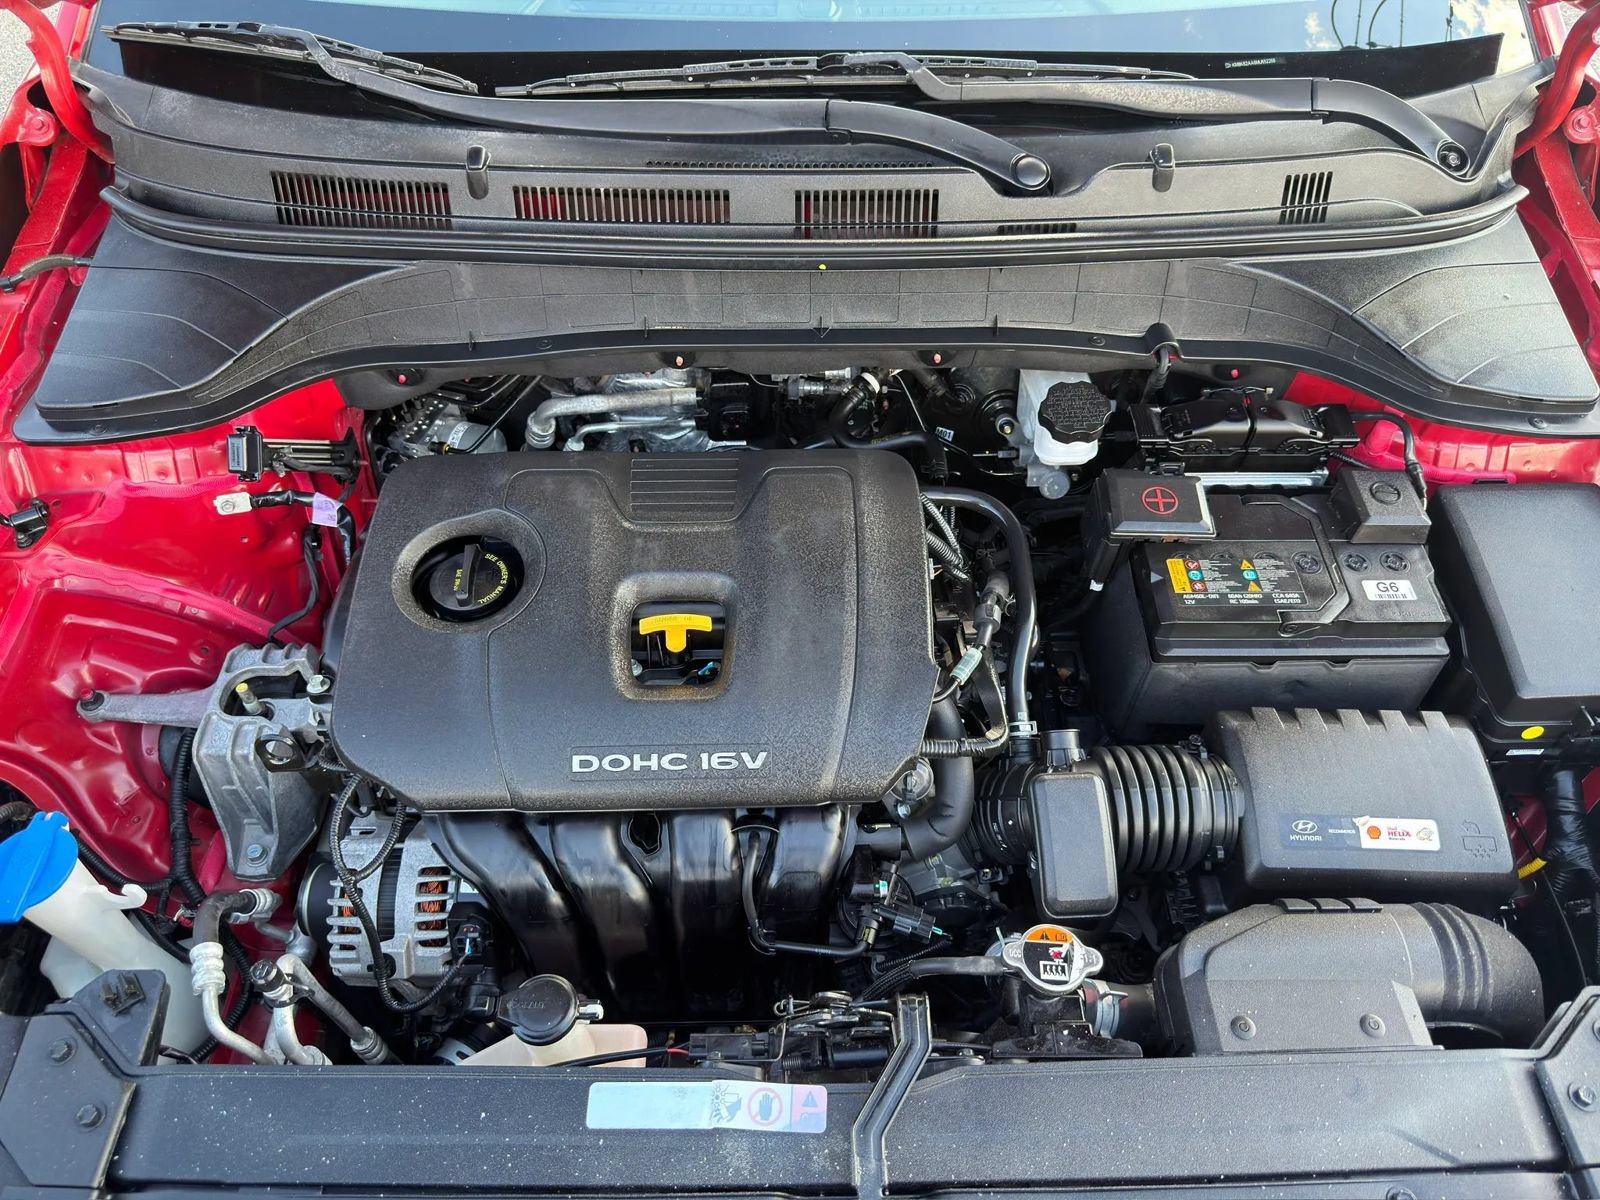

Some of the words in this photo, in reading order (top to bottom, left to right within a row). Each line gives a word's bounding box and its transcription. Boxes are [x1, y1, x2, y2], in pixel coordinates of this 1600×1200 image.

[484, 553, 498, 562] SEE
[496, 560, 509, 585] OWNER'S
[478, 585, 504, 604] MANUAL
[1376, 581, 1399, 592] G6
[571, 752, 688, 773] DOHC
[700, 751, 768, 770] 16V
